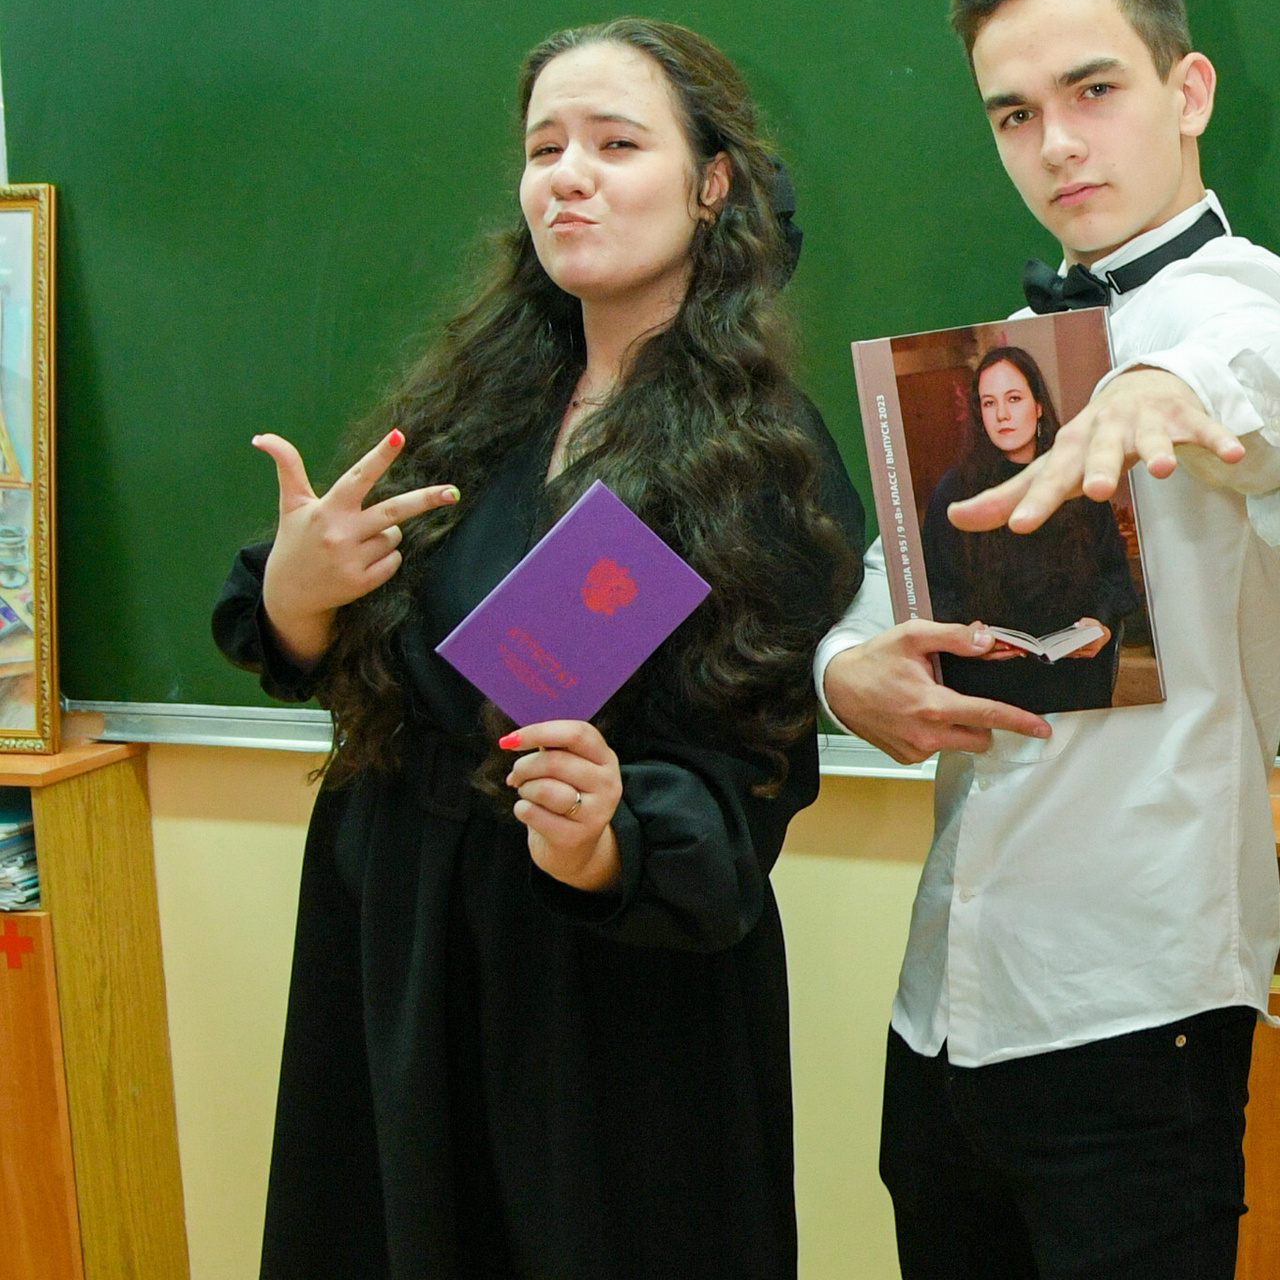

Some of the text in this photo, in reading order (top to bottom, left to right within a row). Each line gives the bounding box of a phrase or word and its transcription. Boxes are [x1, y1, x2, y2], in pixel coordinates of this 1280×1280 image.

[876, 394, 887, 420] 2023
[880, 420, 894, 465] ВЫПУСК
[888, 471, 901, 506] КЛАСС
[899, 540, 908, 553] 95
[902, 554, 910, 565] №
[903, 566, 917, 605] ШКОЛА
